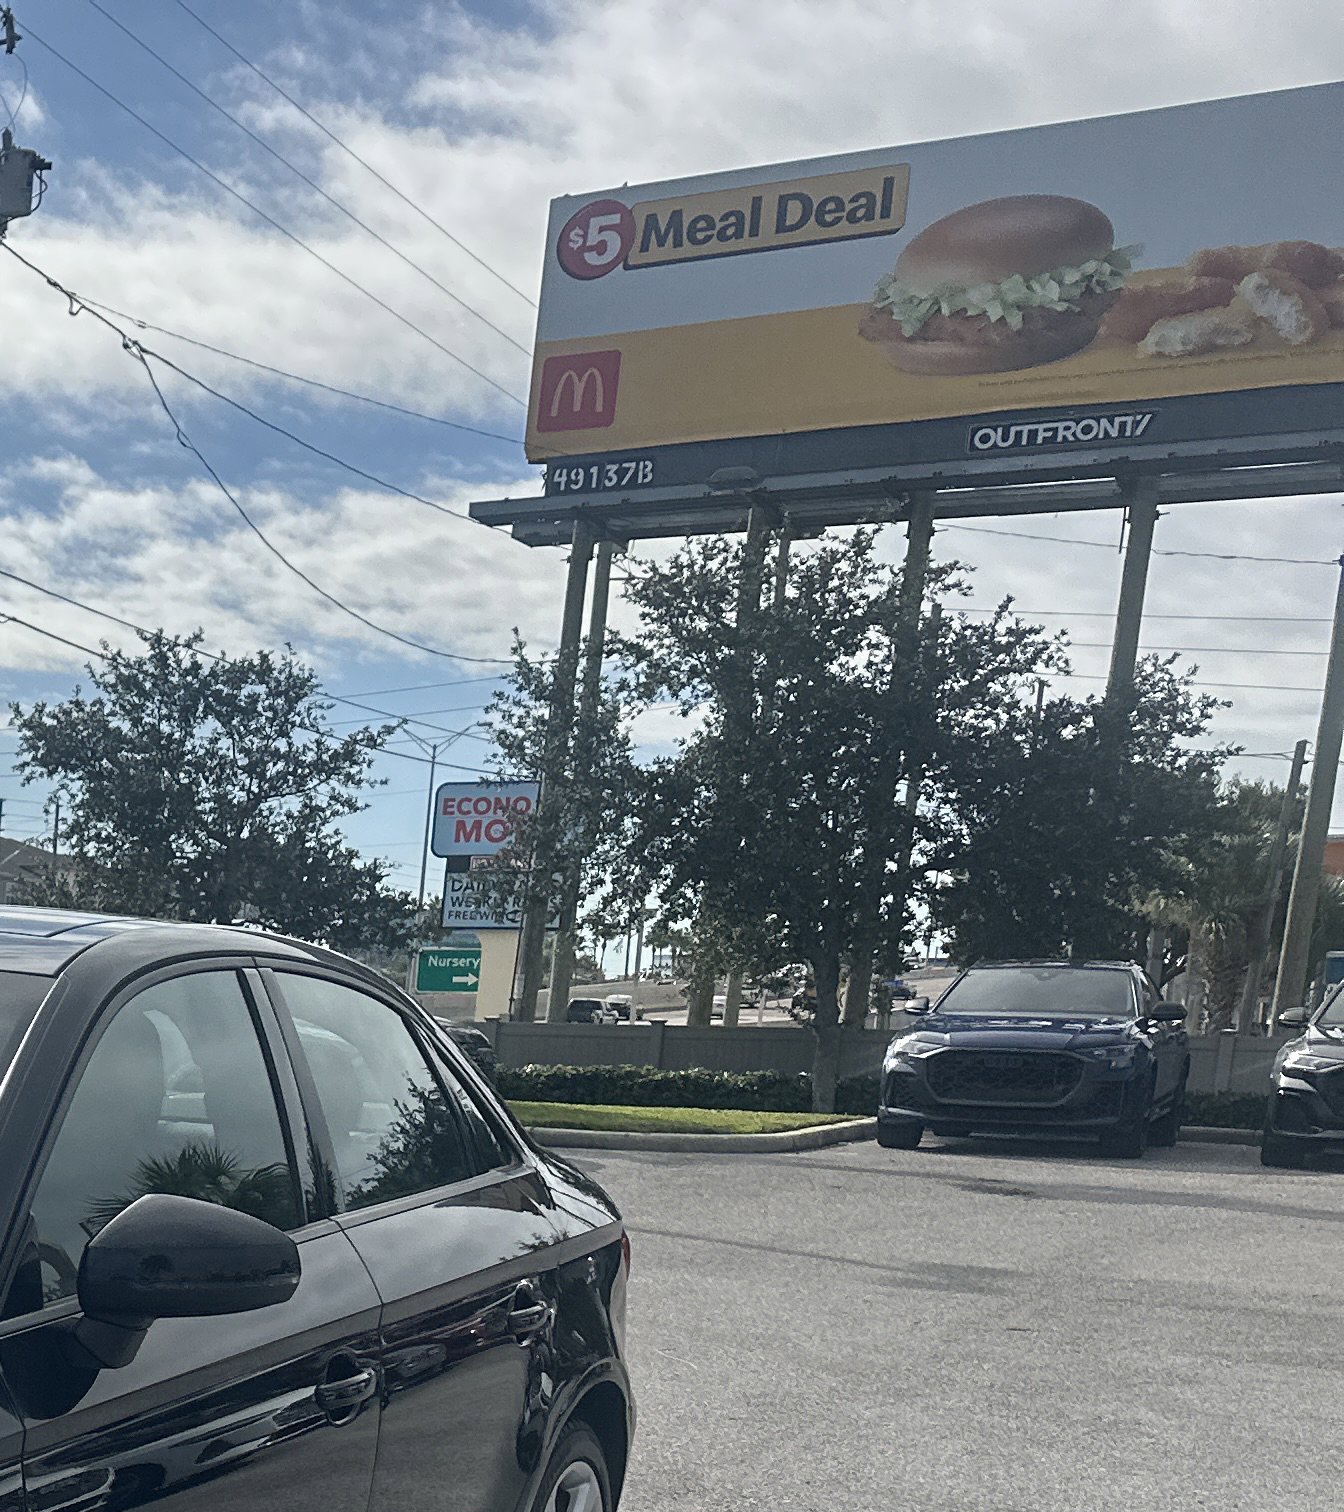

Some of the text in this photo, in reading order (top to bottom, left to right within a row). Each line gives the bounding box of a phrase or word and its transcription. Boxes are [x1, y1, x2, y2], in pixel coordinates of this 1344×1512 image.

[568, 176, 896, 267] $5 Meal Deal
[553, 460, 653, 491] 49137B
[427, 955, 481, 969] Nursery
